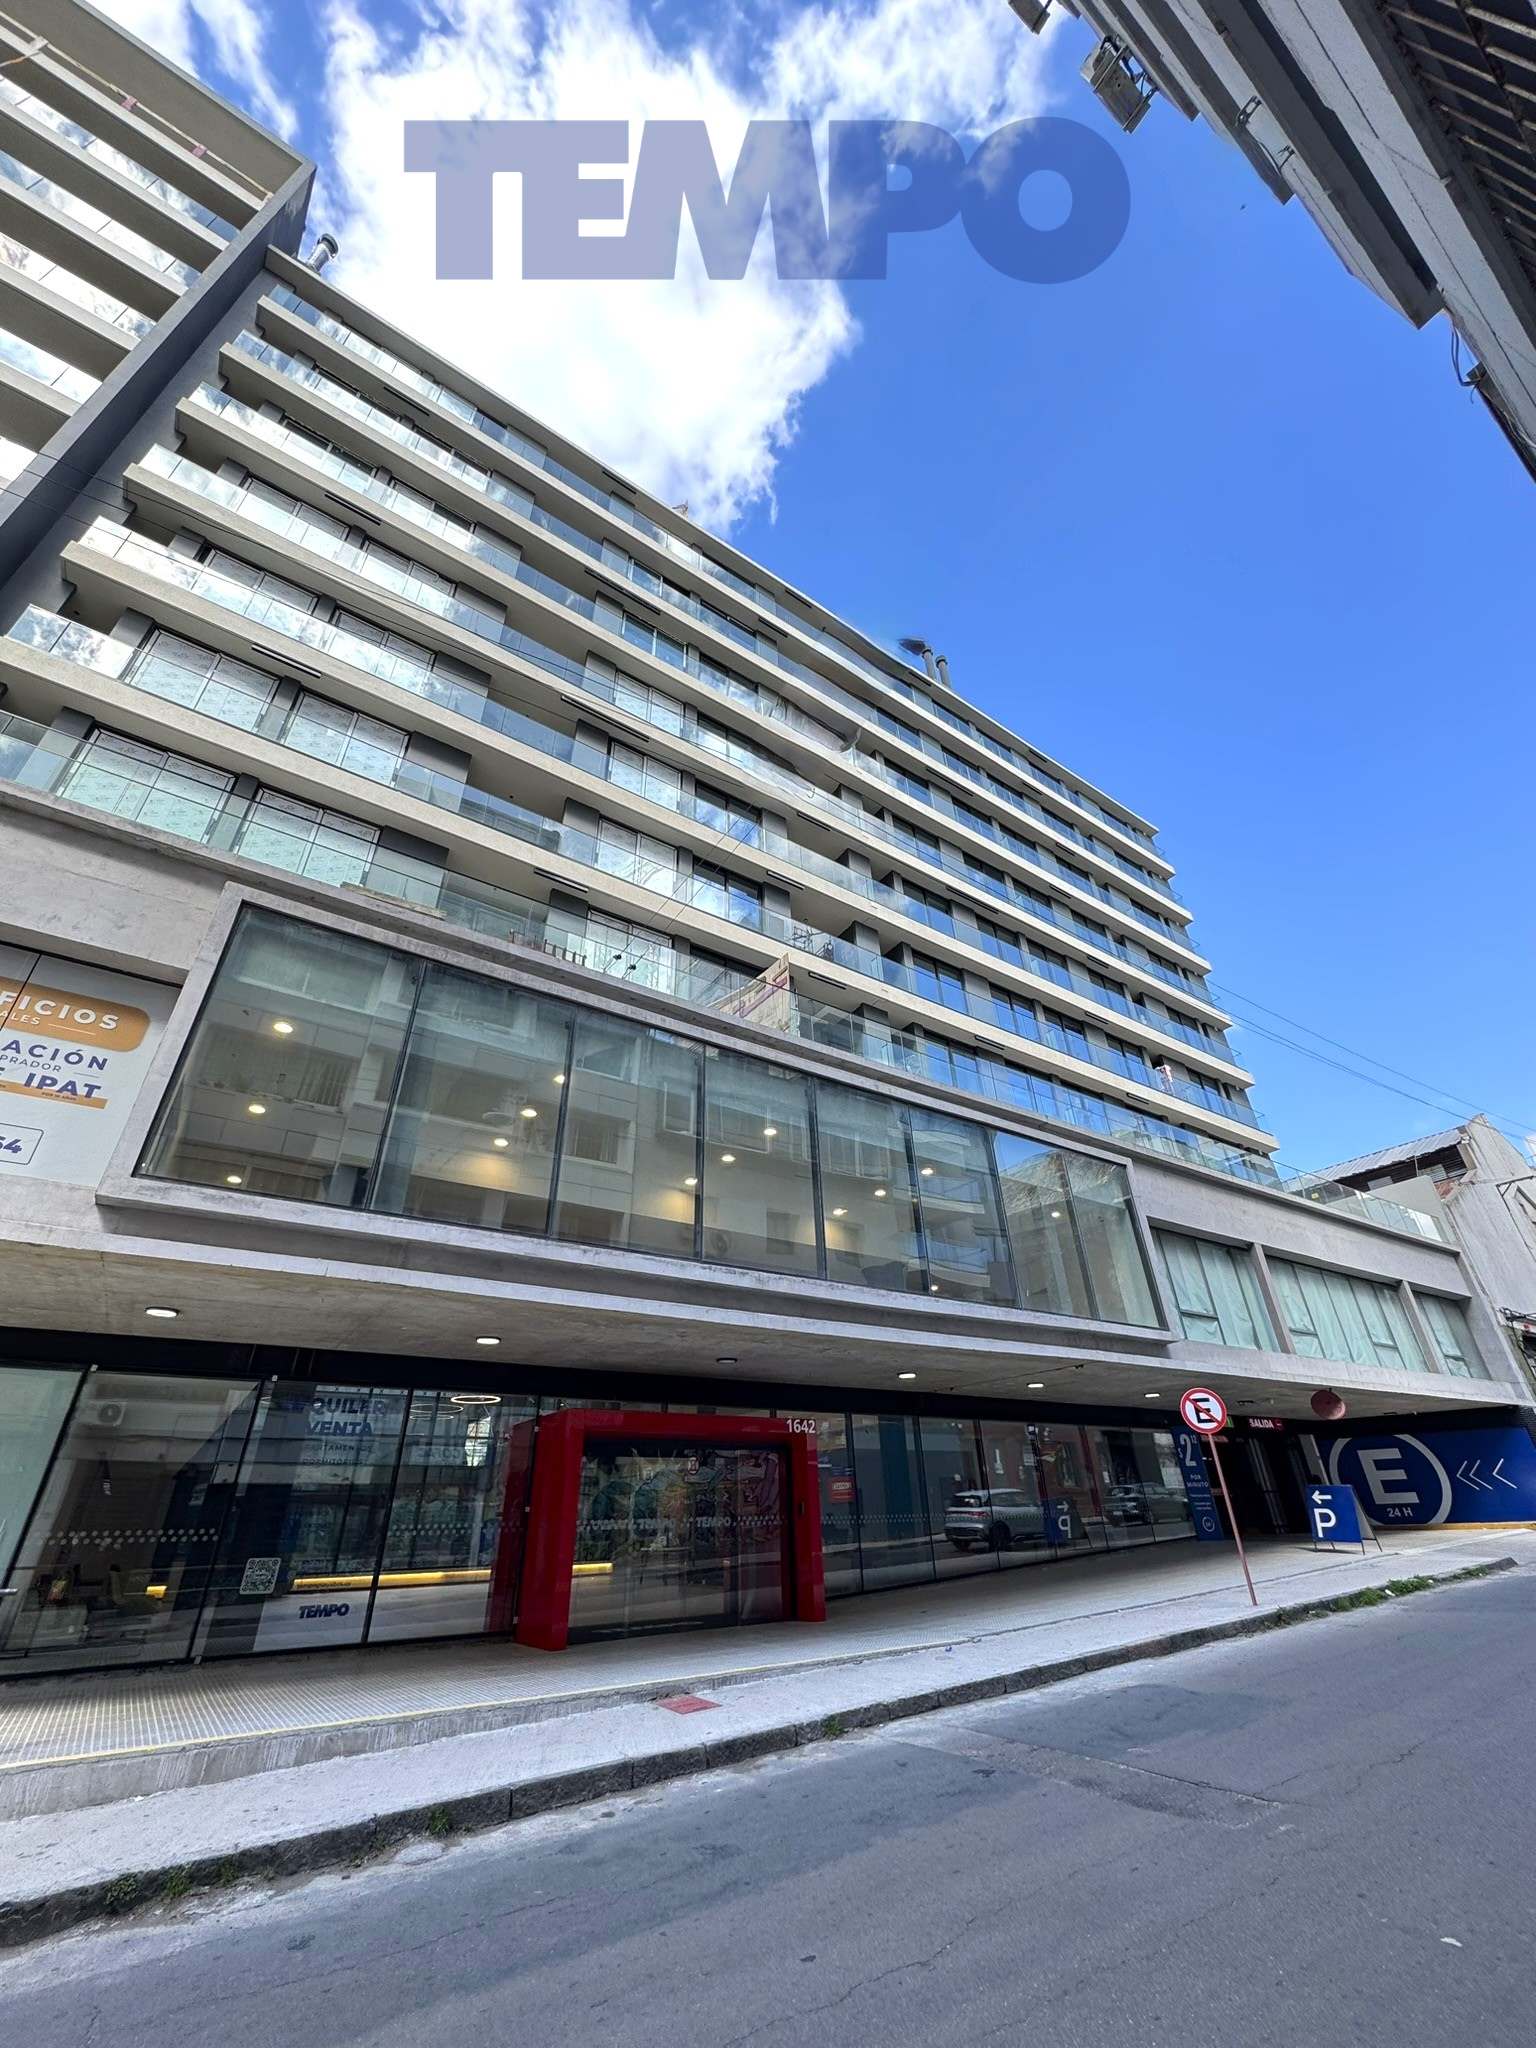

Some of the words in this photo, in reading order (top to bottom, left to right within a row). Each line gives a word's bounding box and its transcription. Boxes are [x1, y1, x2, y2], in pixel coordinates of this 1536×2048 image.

[1, 1039, 108, 1070] ACIÓN
[23, 1072, 102, 1099] IPAT
[1192, 1397, 1215, 1423] E
[306, 1421, 373, 1436] VENTA
[786, 1419, 815, 1433] 1642
[1249, 1418, 1275, 1429] SALIDA
[1357, 1448, 1420, 1505] E
[1387, 1507, 1401, 1518] 24
[1404, 1507, 1413, 1517] H
[696, 1516, 732, 1528] TEMPO
[1314, 1508, 1336, 1538] P
[299, 1603, 350, 1619] TEMPO
